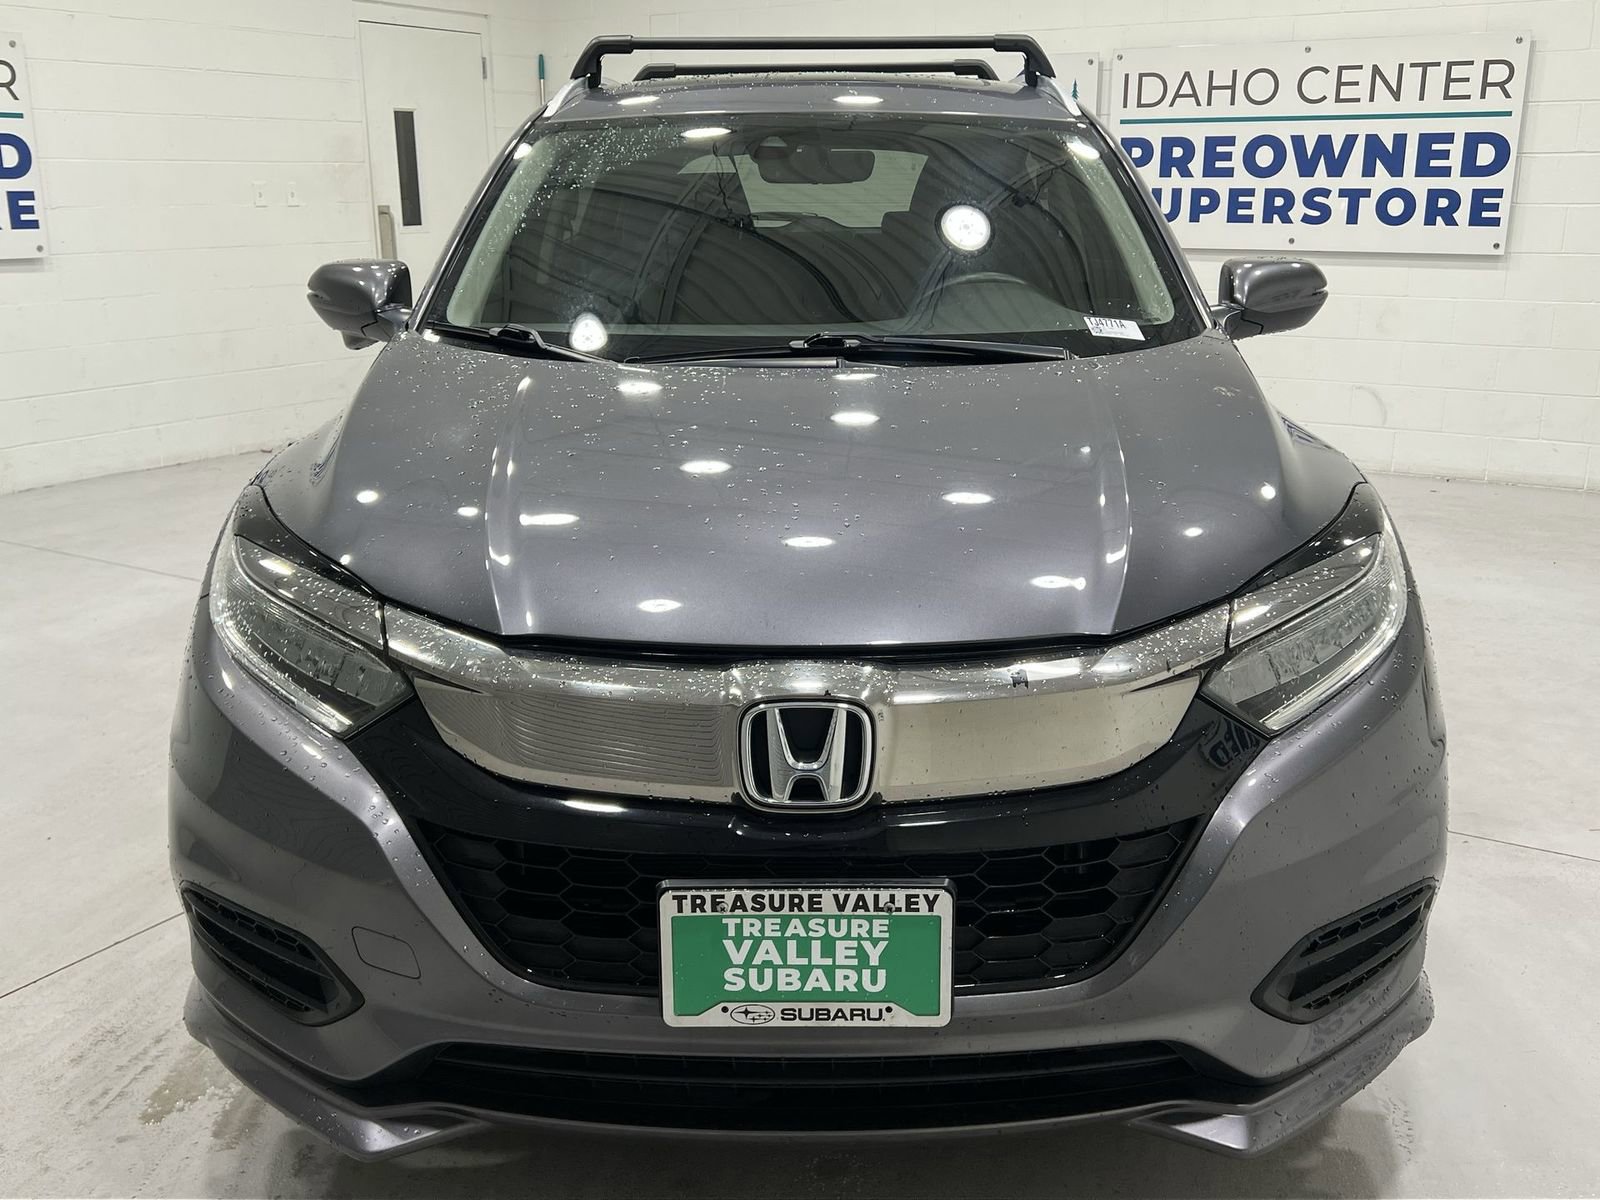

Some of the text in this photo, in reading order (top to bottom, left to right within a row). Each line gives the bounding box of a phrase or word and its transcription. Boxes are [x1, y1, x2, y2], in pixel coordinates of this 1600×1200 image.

[1121, 58, 1516, 109] IDAHO CENTER
[1120, 131, 1512, 179] PREOWNED
[1151, 187, 1504, 227] UPERSTORE
[672, 893, 941, 914] TREASURE VALLEY
[722, 918, 890, 938] TREASURE
[722, 939, 890, 966] VALLEY
[723, 967, 887, 993] SUBARU
[780, 1007, 883, 1022] SUBARU
